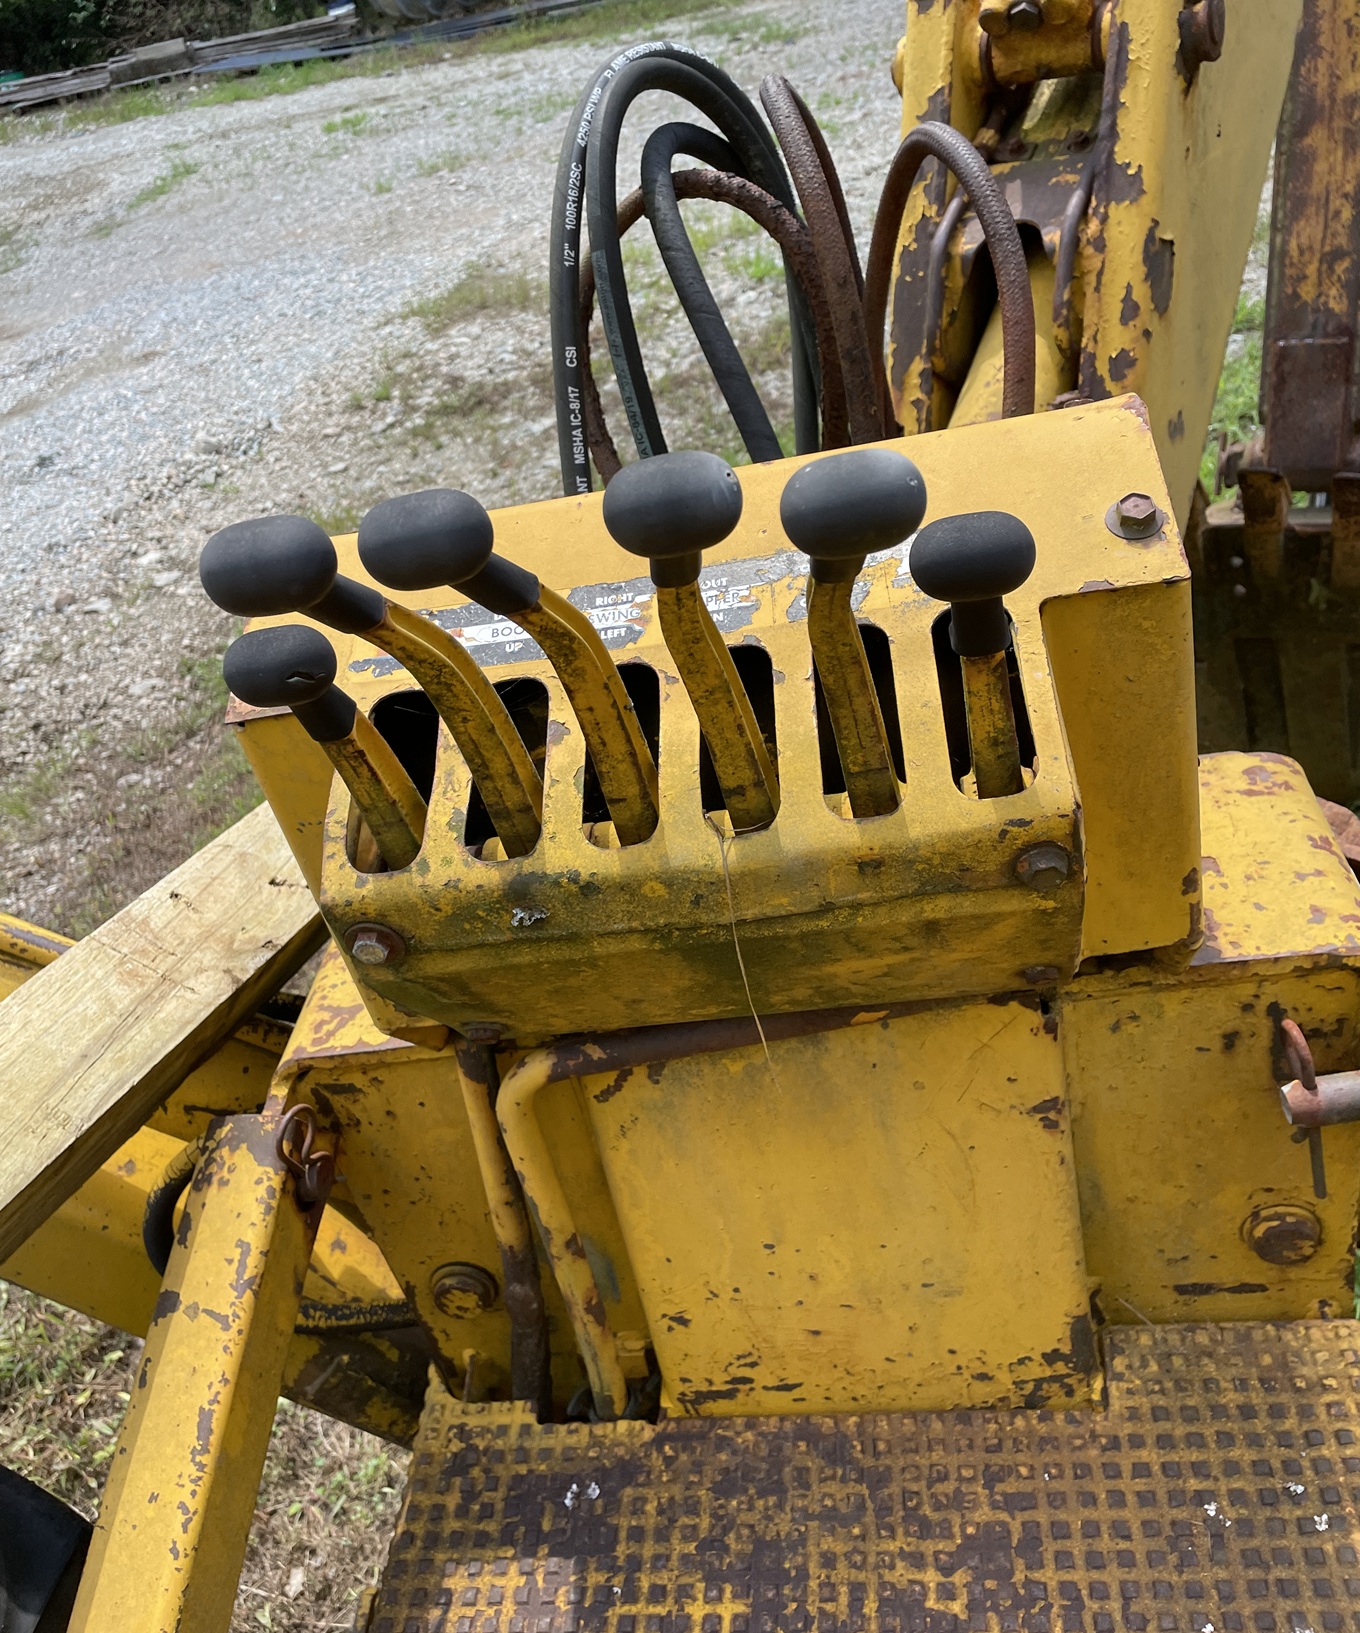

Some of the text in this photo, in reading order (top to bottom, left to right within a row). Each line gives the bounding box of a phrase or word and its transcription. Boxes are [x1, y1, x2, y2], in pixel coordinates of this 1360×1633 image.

[625, 41, 667, 60] RESISTANT
[604, 53, 630, 79] FLAME
[590, 87, 602, 103] WP
[583, 102, 597, 121] PSI
[577, 121, 591, 147] 4250
[565, 162, 583, 230] 100R16/2SC
[564, 243, 575, 267] 1/2"
[565, 346, 577, 368] CSI
[567, 386, 581, 426] IC-8/17
[572, 428, 585, 464] MSHA
[701, 577, 728, 589] OUT
[595, 593, 634, 606] RIGHT
[588, 608, 641, 624] SWING
[491, 626, 525, 638] BOO
[600, 627, 627, 640] LEFT
[505, 641, 523, 652] UP
